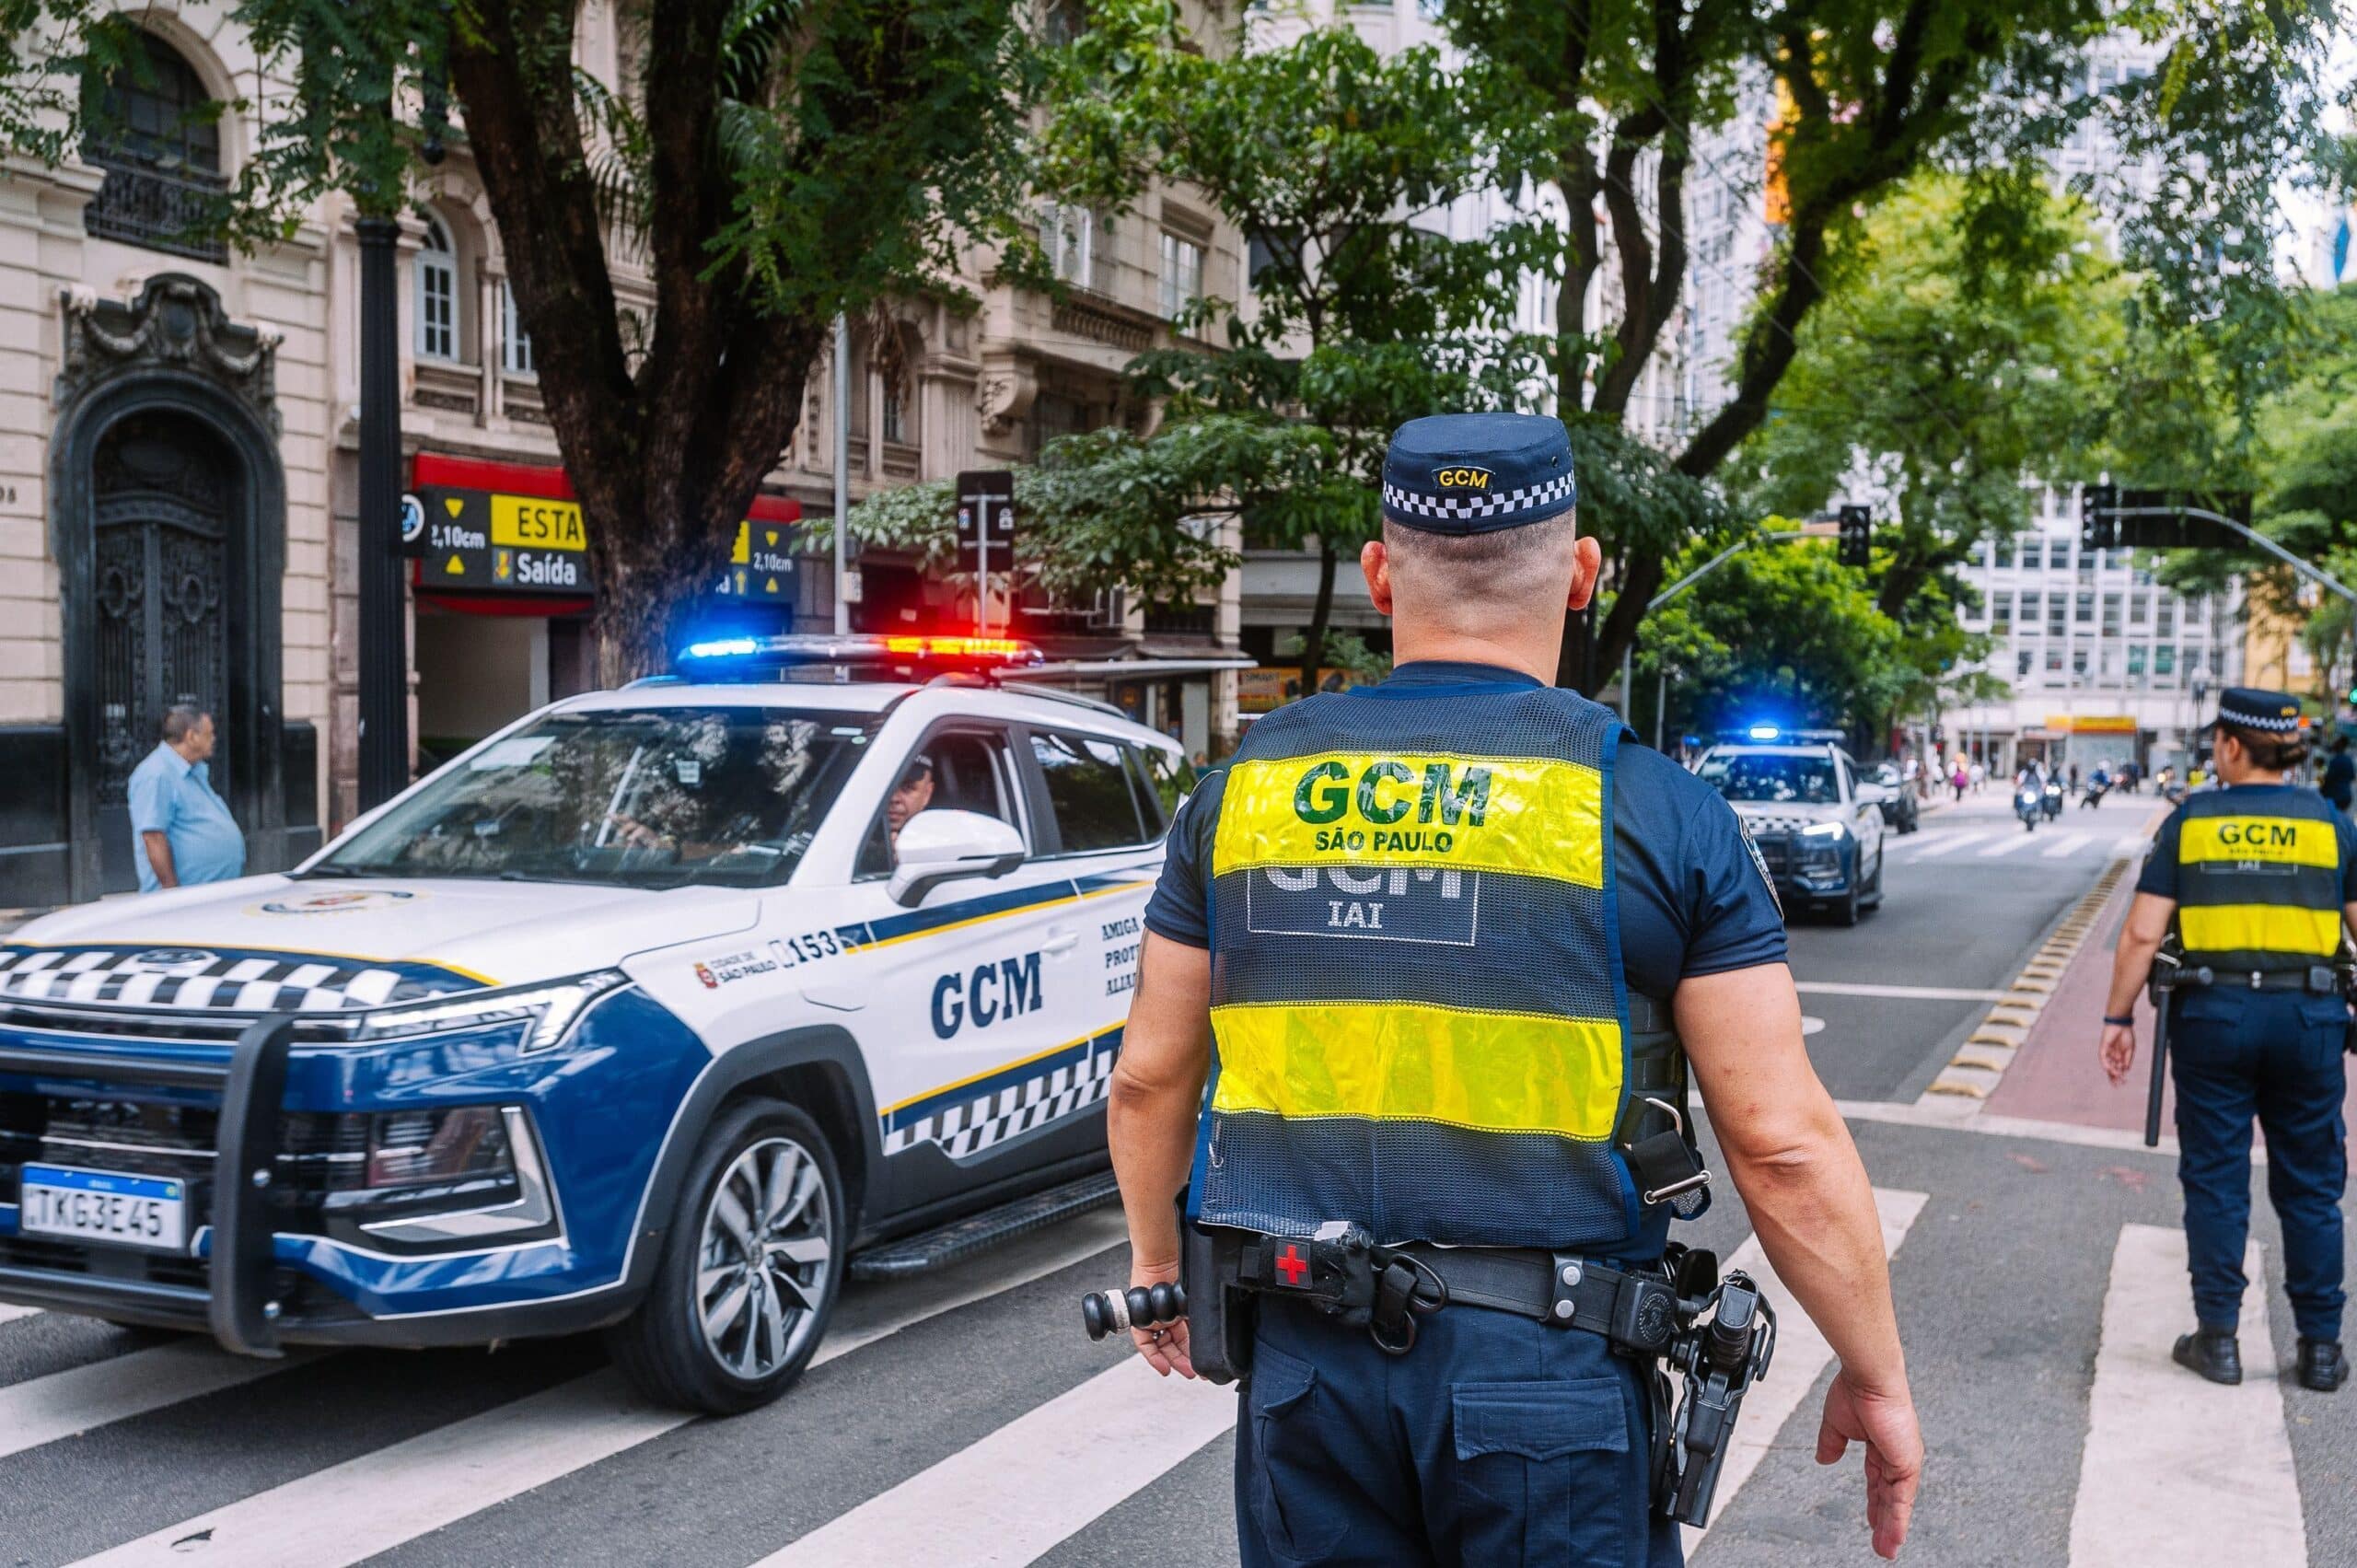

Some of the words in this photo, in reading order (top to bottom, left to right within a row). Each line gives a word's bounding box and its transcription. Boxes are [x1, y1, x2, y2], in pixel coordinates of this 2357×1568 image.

[1439, 470, 1489, 489] GCM
[517, 507, 580, 541] ESTA
[517, 552, 577, 585] Saída
[753, 552, 794, 573] 2,10cm
[1294, 761, 1492, 827] GCM
[1315, 827, 1364, 852] SÃO
[1374, 830, 1453, 853] PAULO
[2219, 824, 2296, 847] GCM
[1101, 917, 1140, 941] AMIGA
[1327, 900, 1384, 929] IAI
[788, 931, 838, 962] 153
[931, 951, 1043, 1040] GCM
[39, 1188, 163, 1237] TKG3E45
